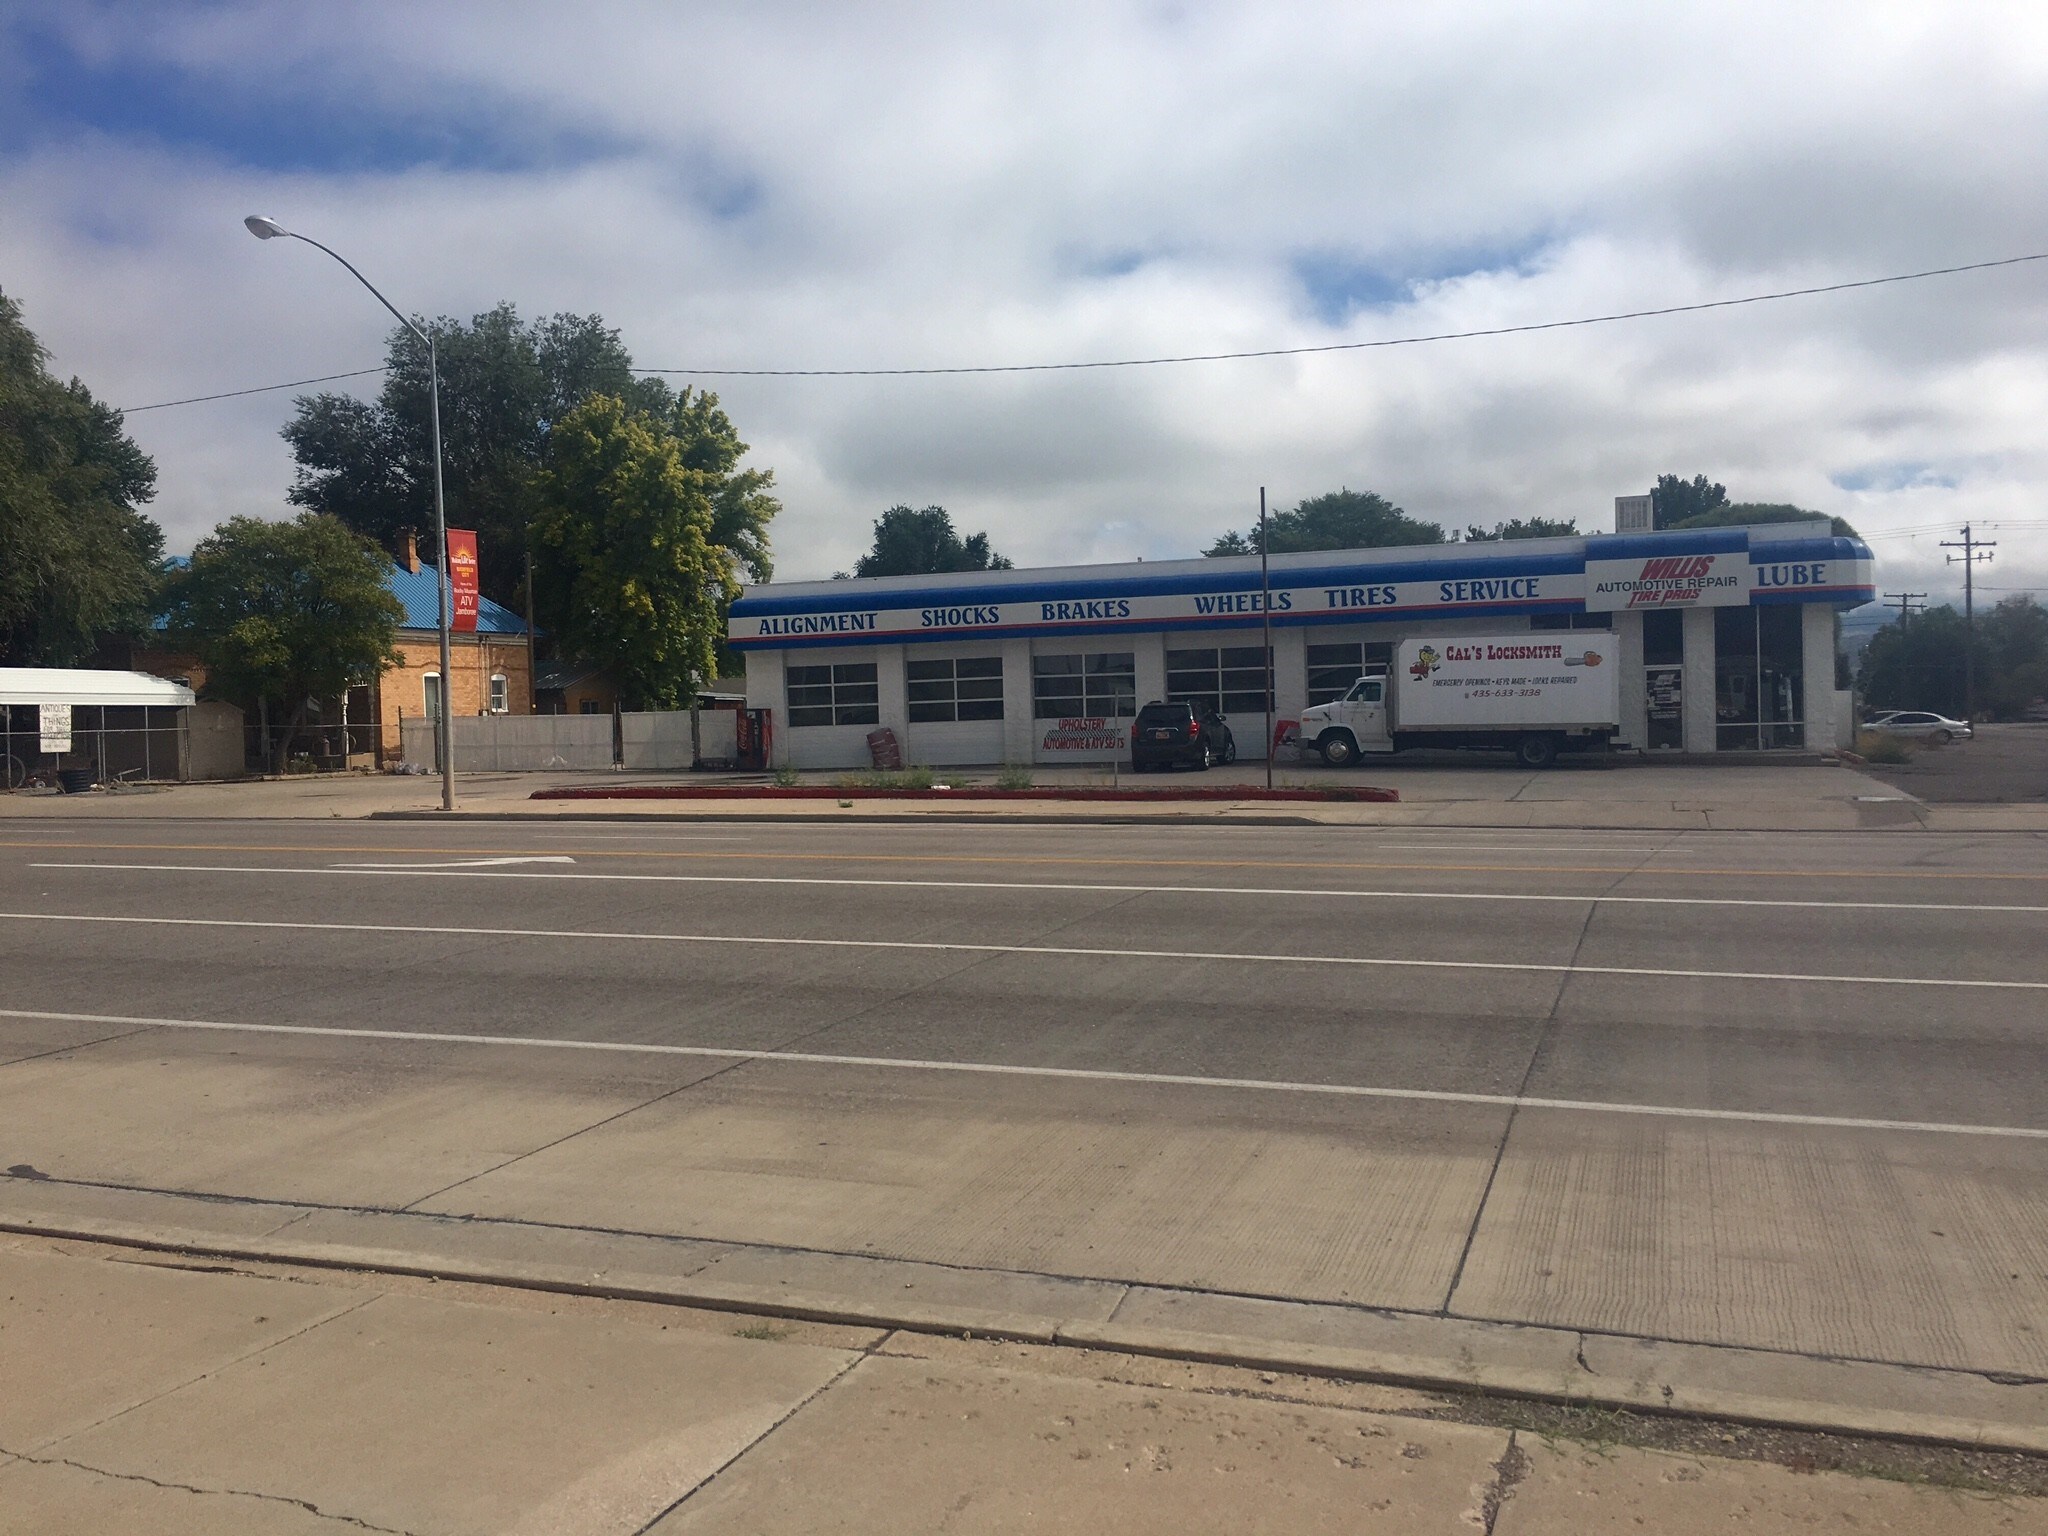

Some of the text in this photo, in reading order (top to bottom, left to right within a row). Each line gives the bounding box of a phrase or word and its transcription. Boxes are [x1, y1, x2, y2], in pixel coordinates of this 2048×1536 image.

[1638, 555, 1716, 581] WILLIS
[1757, 563, 1827, 587] LUBE
[1439, 577, 1540, 602] SERVICE
[1595, 576, 1738, 594] AUTOMOTIVE REPAIR
[460, 596, 473, 606] ATV
[1194, 591, 1292, 614] WHEELS
[1324, 586, 1397, 608] TIRES
[1627, 588, 1702, 608] TIRE PROS
[456, 608, 476, 616] Jamboree
[921, 606, 1000, 627] SHOCKS
[1041, 599, 1131, 621] BRAKES
[758, 612, 878, 635] ALIGNMENT
[1432, 679, 1463, 687] EMERGENCY
[1495, 677, 1509, 686] KEYS
[1511, 677, 1527, 686] MADE
[1550, 676, 1578, 685] REPAIRED
[1471, 688, 1542, 698] 435-633-3138
[41, 704, 70, 712] ANTIQUES
[43, 716, 70, 727] THINGS
[1058, 718, 1106, 730] UPHOLSTERY
[1043, 737, 1085, 750] AUTOMOTIVE
[1091, 737, 1105, 750] ATV
